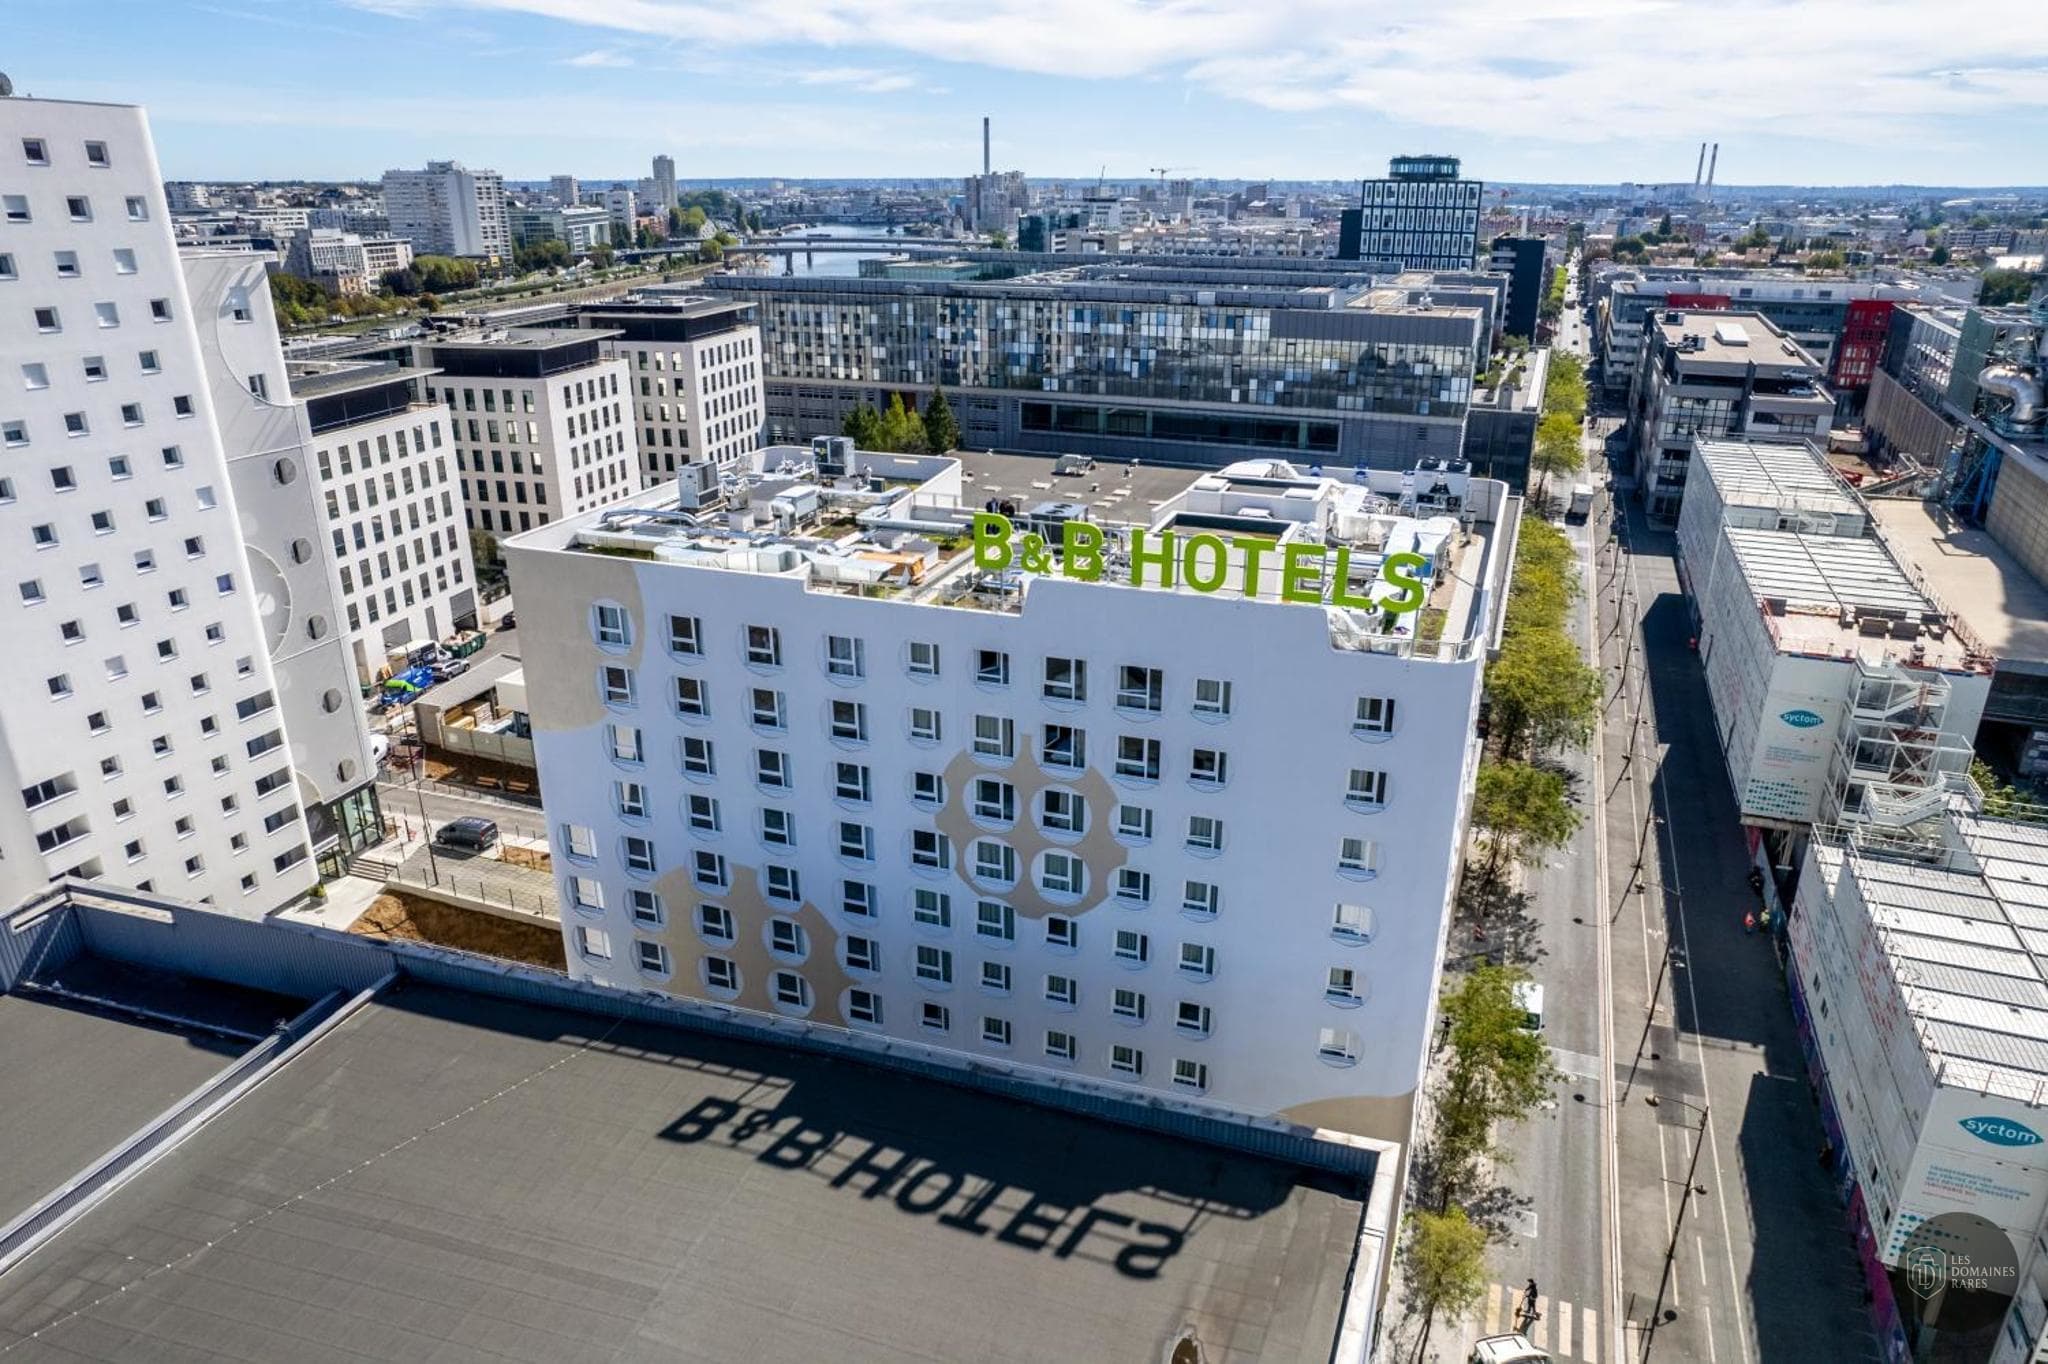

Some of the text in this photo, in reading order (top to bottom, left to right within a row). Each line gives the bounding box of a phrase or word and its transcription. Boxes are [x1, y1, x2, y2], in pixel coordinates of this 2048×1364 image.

[973, 511, 1426, 614] B&B HOTELS
[1966, 1120, 2037, 1144] syctom
